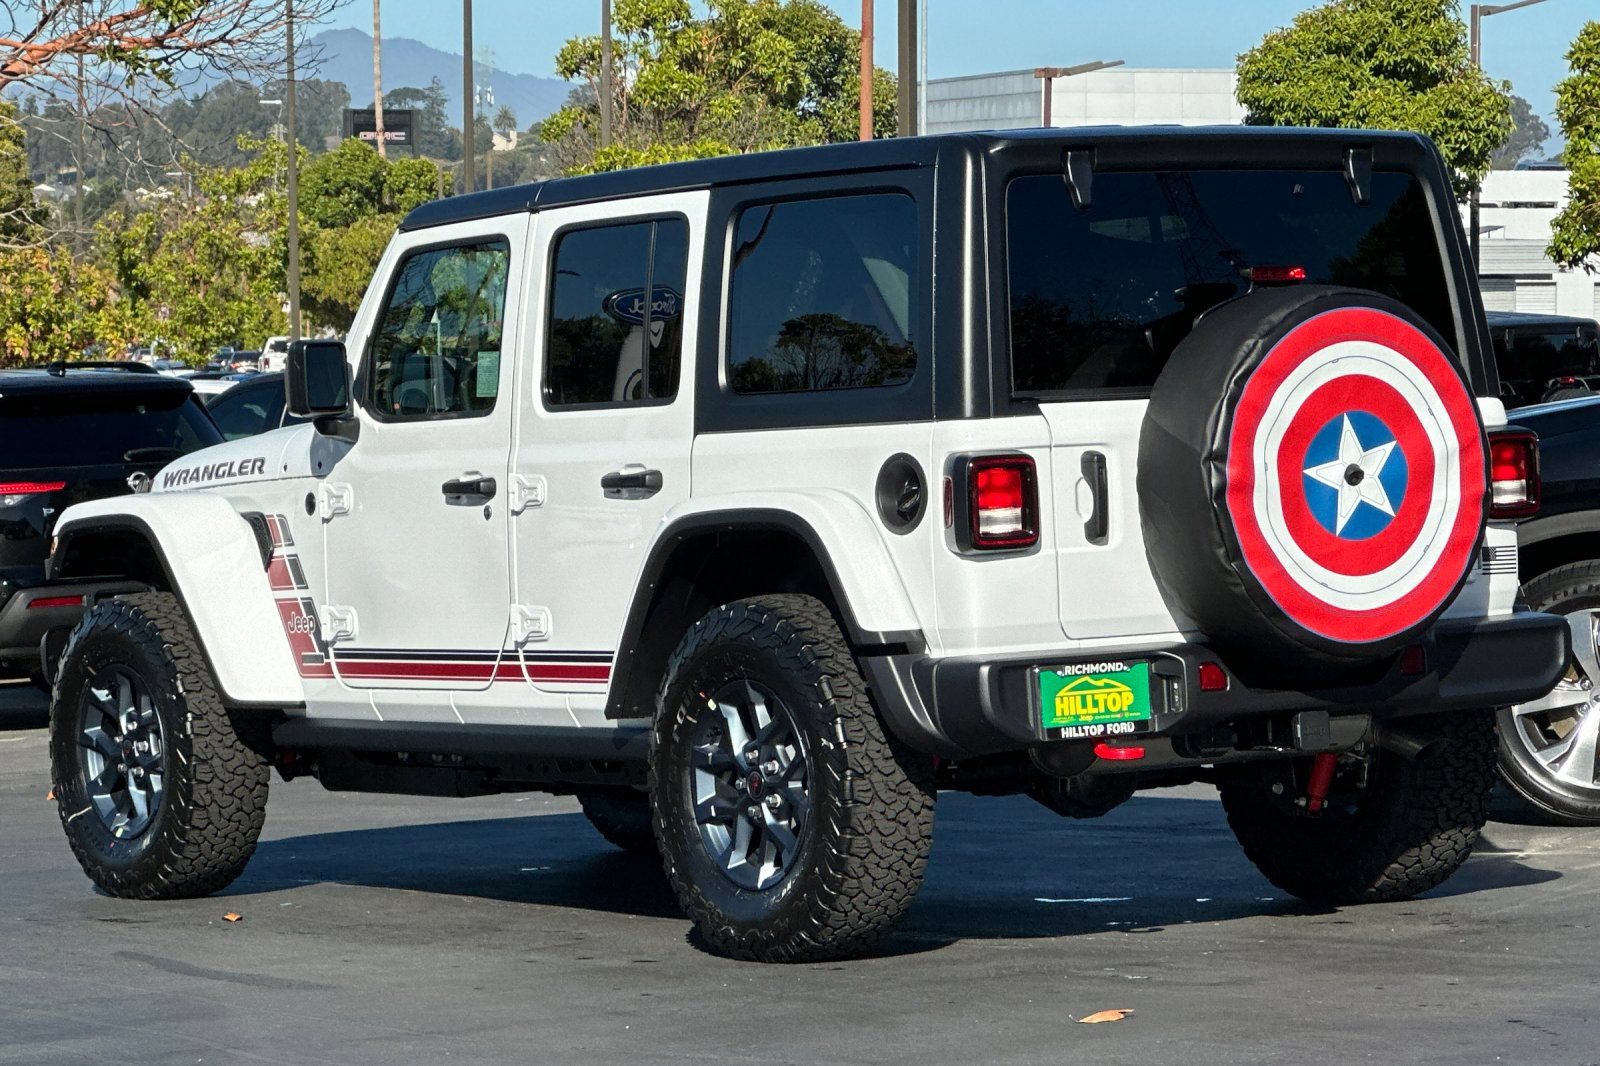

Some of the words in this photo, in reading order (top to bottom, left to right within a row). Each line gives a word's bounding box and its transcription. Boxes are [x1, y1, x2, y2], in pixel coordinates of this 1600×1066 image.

[163, 457, 265, 488] WRANGLER
[288, 611, 315, 637] Jeep
[1064, 662, 1124, 675] RICHMOND
[1055, 691, 1134, 716] HILLTOP
[1061, 724, 1104, 738] HILLTOP
[1106, 721, 1135, 735] FORD
